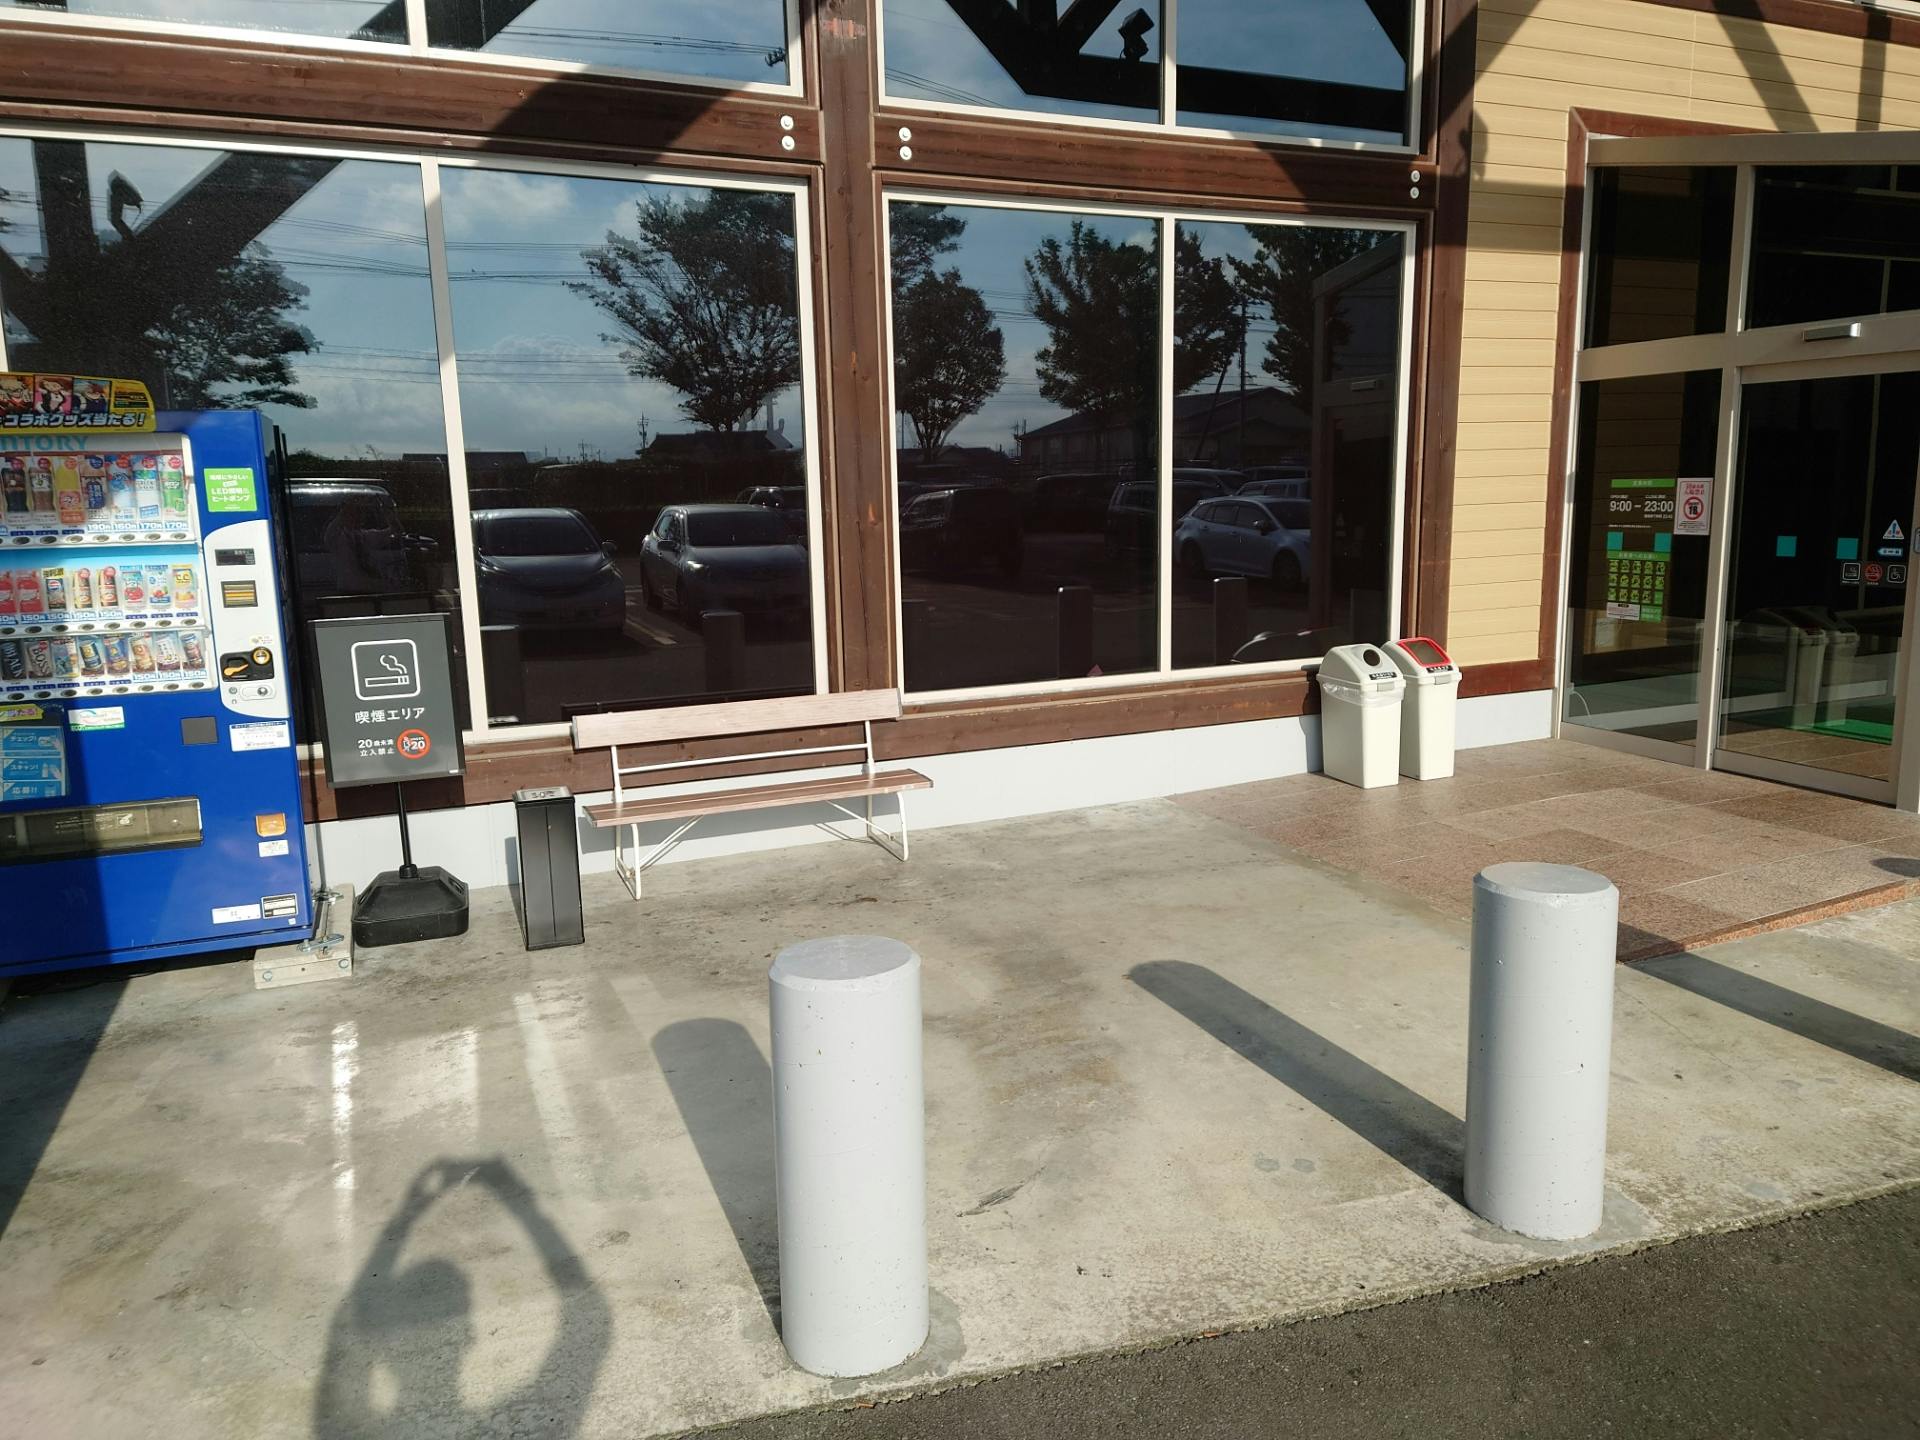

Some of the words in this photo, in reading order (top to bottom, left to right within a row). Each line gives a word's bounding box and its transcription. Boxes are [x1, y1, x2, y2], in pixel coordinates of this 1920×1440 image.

[0, 412, 146, 427] コラボグッズ当たる!
[1609, 500, 1632, 512] 9:00
[1644, 500, 1674, 512] 23:00
[31, 647, 50, 675] BOSS
[354, 707, 425, 724] 喫煙エリア
[357, 738, 395, 750] 20歳未満
[411, 740, 426, 750] 20
[360, 747, 395, 757] 立入禁止
